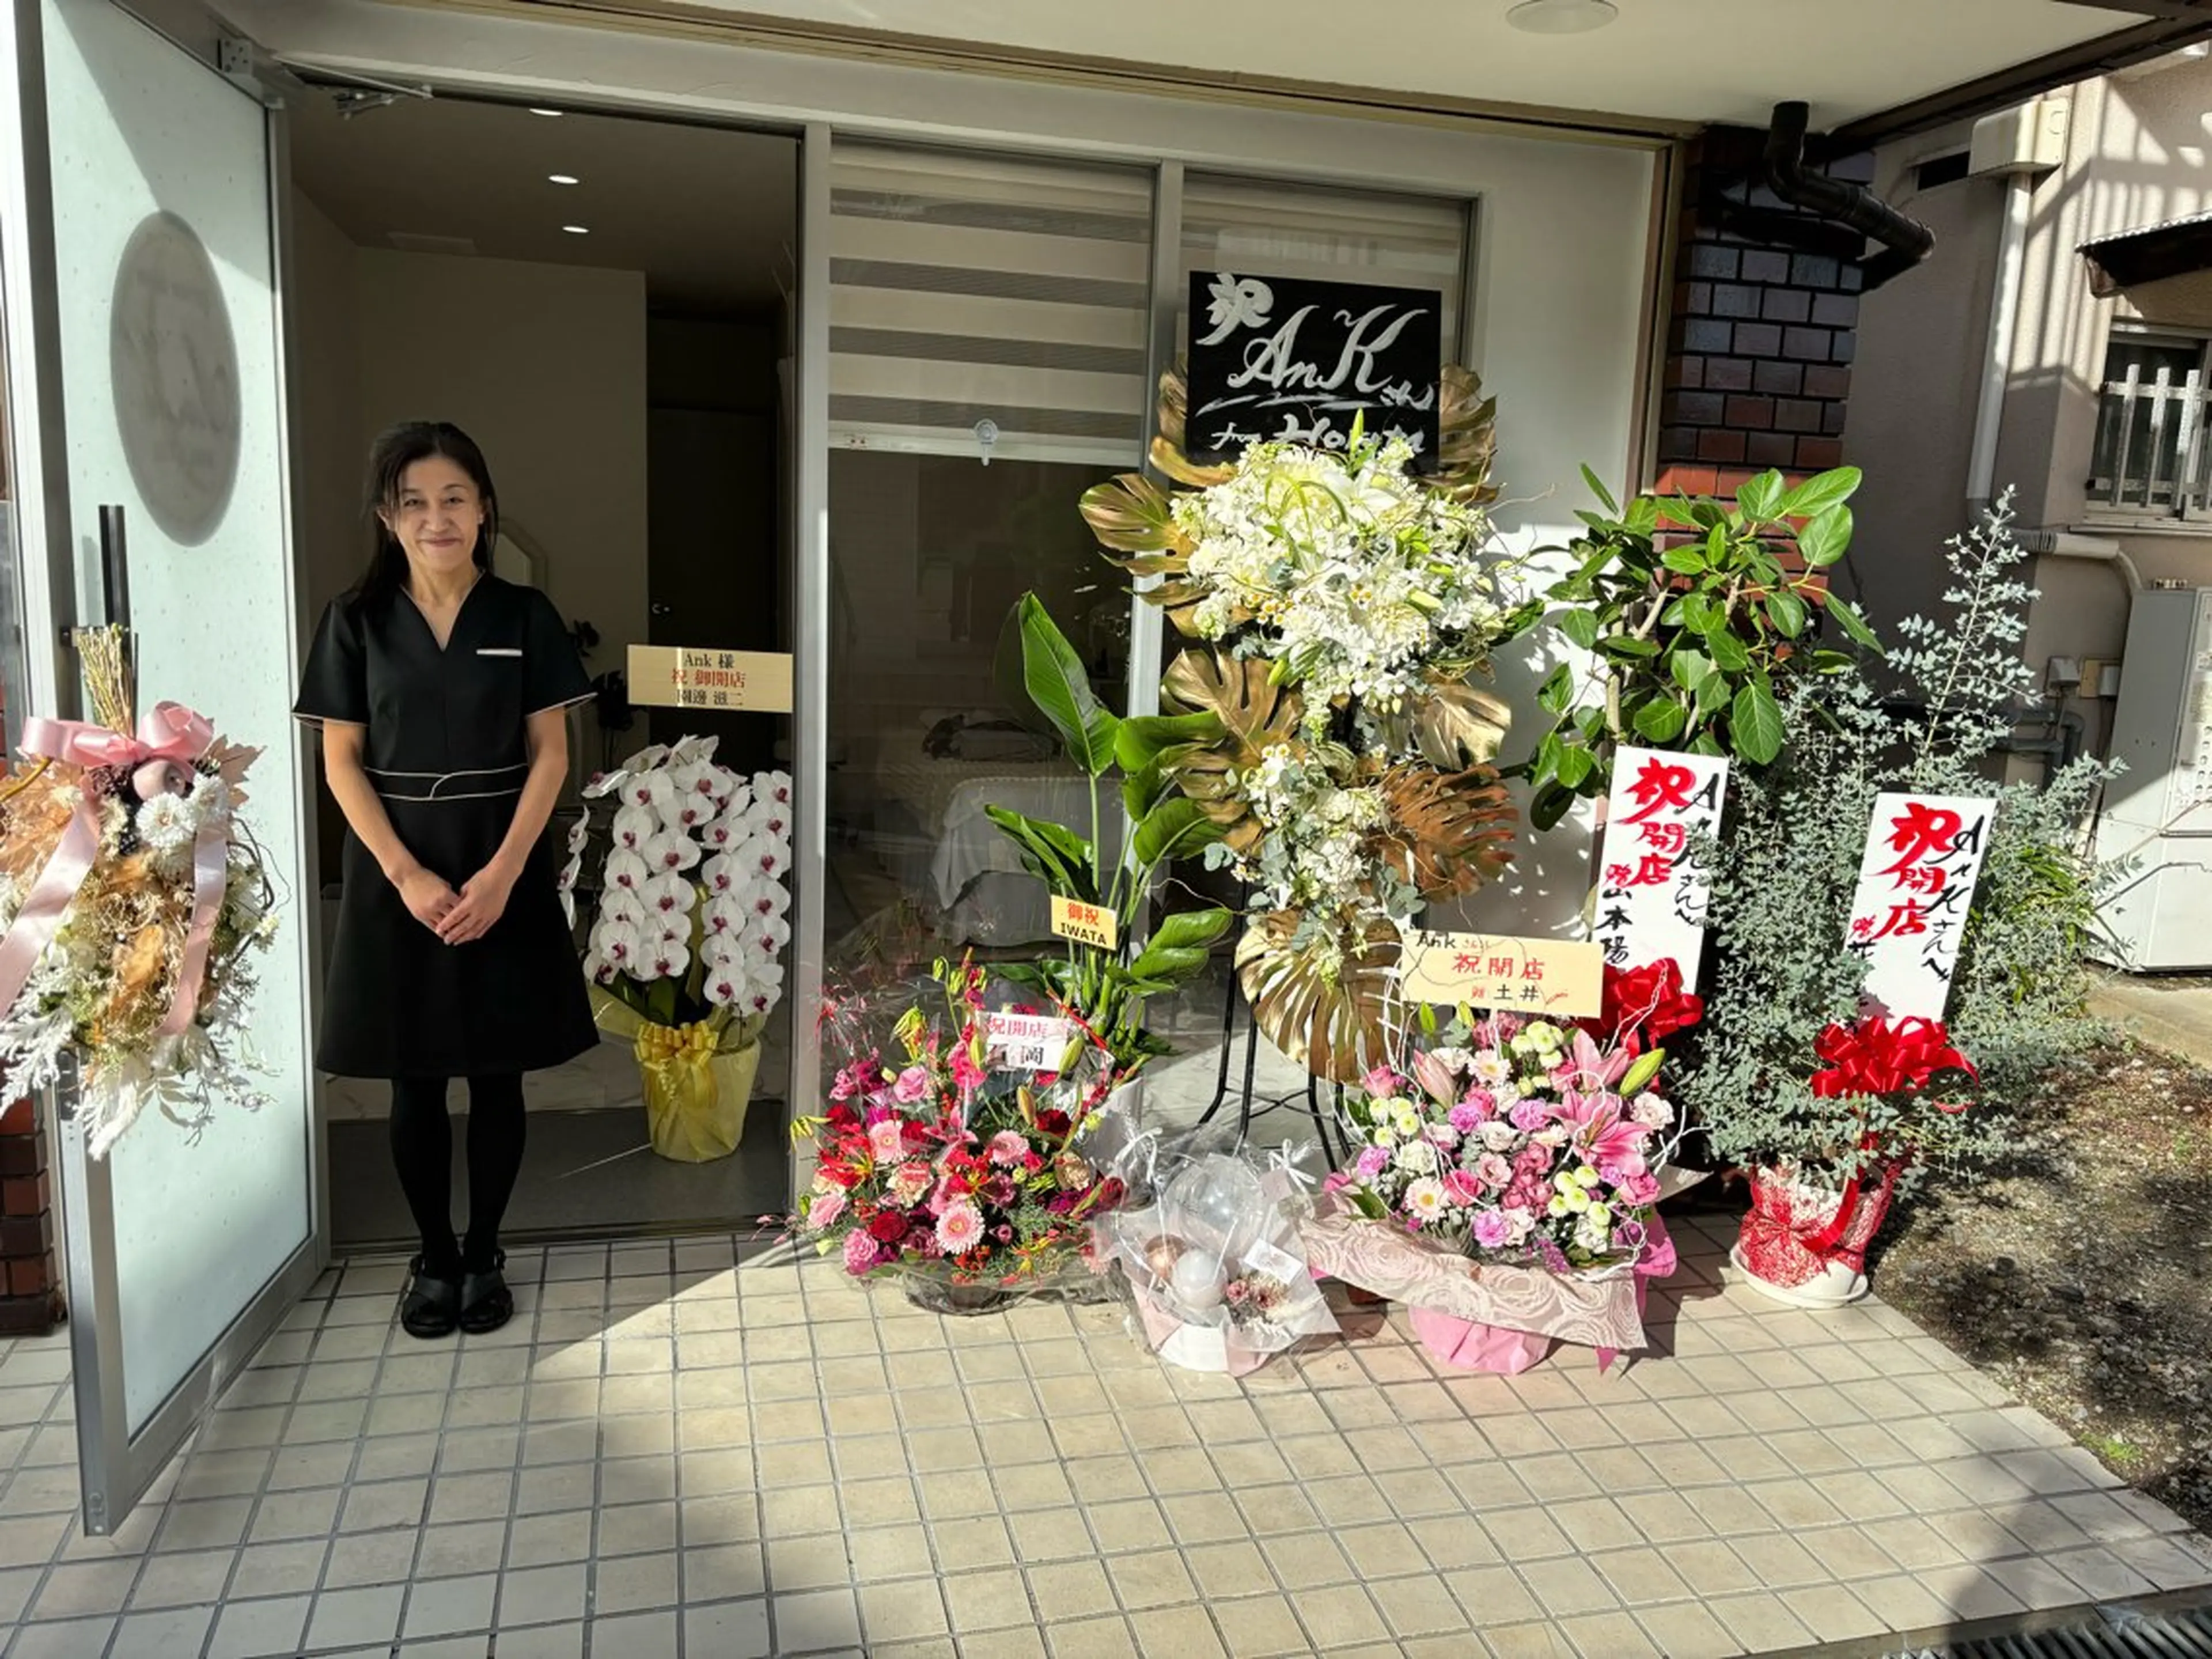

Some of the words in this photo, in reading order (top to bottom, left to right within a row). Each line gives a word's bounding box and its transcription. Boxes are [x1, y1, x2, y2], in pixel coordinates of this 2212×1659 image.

[685, 653, 712, 667] Ank
[718, 653, 734, 669] 様
[694, 669, 746, 688] 御開店
[1067, 902, 1099, 926] 御祝
[1061, 922, 1107, 945] IWATA
[1416, 932, 1456, 949] Ank
[1452, 953, 1545, 980] 祝開店
[1494, 984, 1539, 1002] 土井
[987, 1017, 1048, 1037] 祝開店
